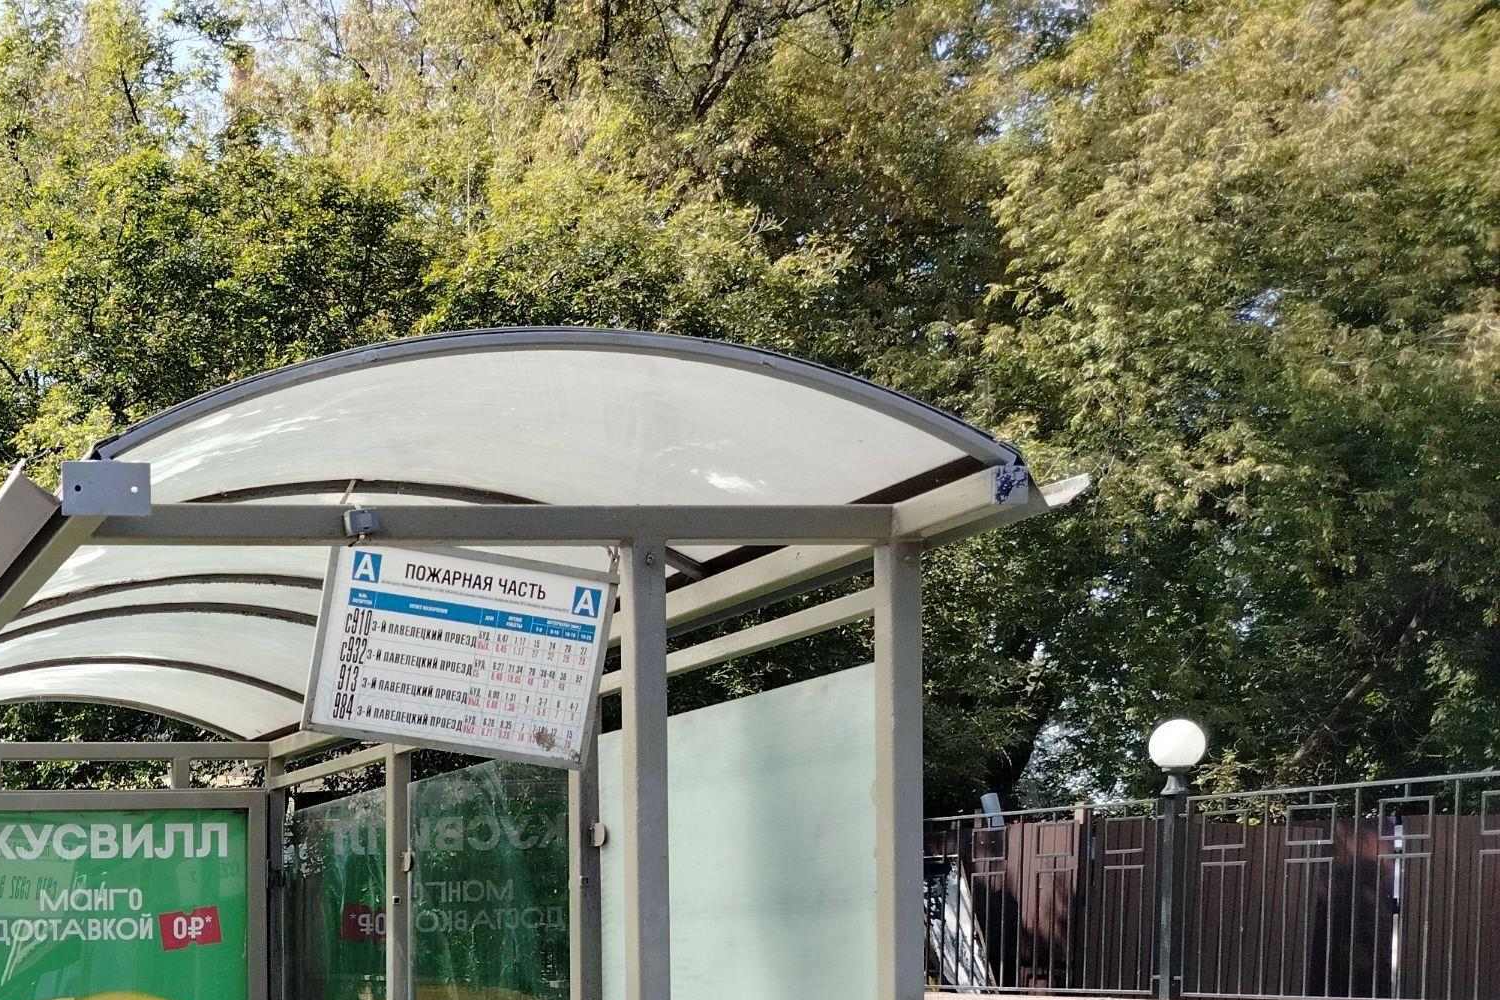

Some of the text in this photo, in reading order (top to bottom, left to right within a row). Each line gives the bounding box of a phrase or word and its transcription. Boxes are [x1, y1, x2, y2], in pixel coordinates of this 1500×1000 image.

[354, 554, 375, 581] А
[405, 563, 493, 592] ПОЖАРНАЯ
[498, 578, 546, 600] ЧАСТЬ
[574, 589, 595, 617] А
[388, 623, 442, 641] ПАВЕЛЕЦКИЙ
[445, 632, 477, 649] ПРОЕЗД
[384, 651, 438, 670] ПАВЕЛЕЦКИЙ
[440, 660, 473, 676] ПРОЕЗД
[338, 664, 359, 692] 913
[378, 680, 433, 698] ПАВЕЛЕЦКИЙ
[435, 688, 468, 705] ПРОЕЗД
[333, 692, 354, 720] 984
[374, 708, 428, 726] ПАВЕЛЕЦКИЙ
[430, 717, 463, 732] ПРОЕЗД
